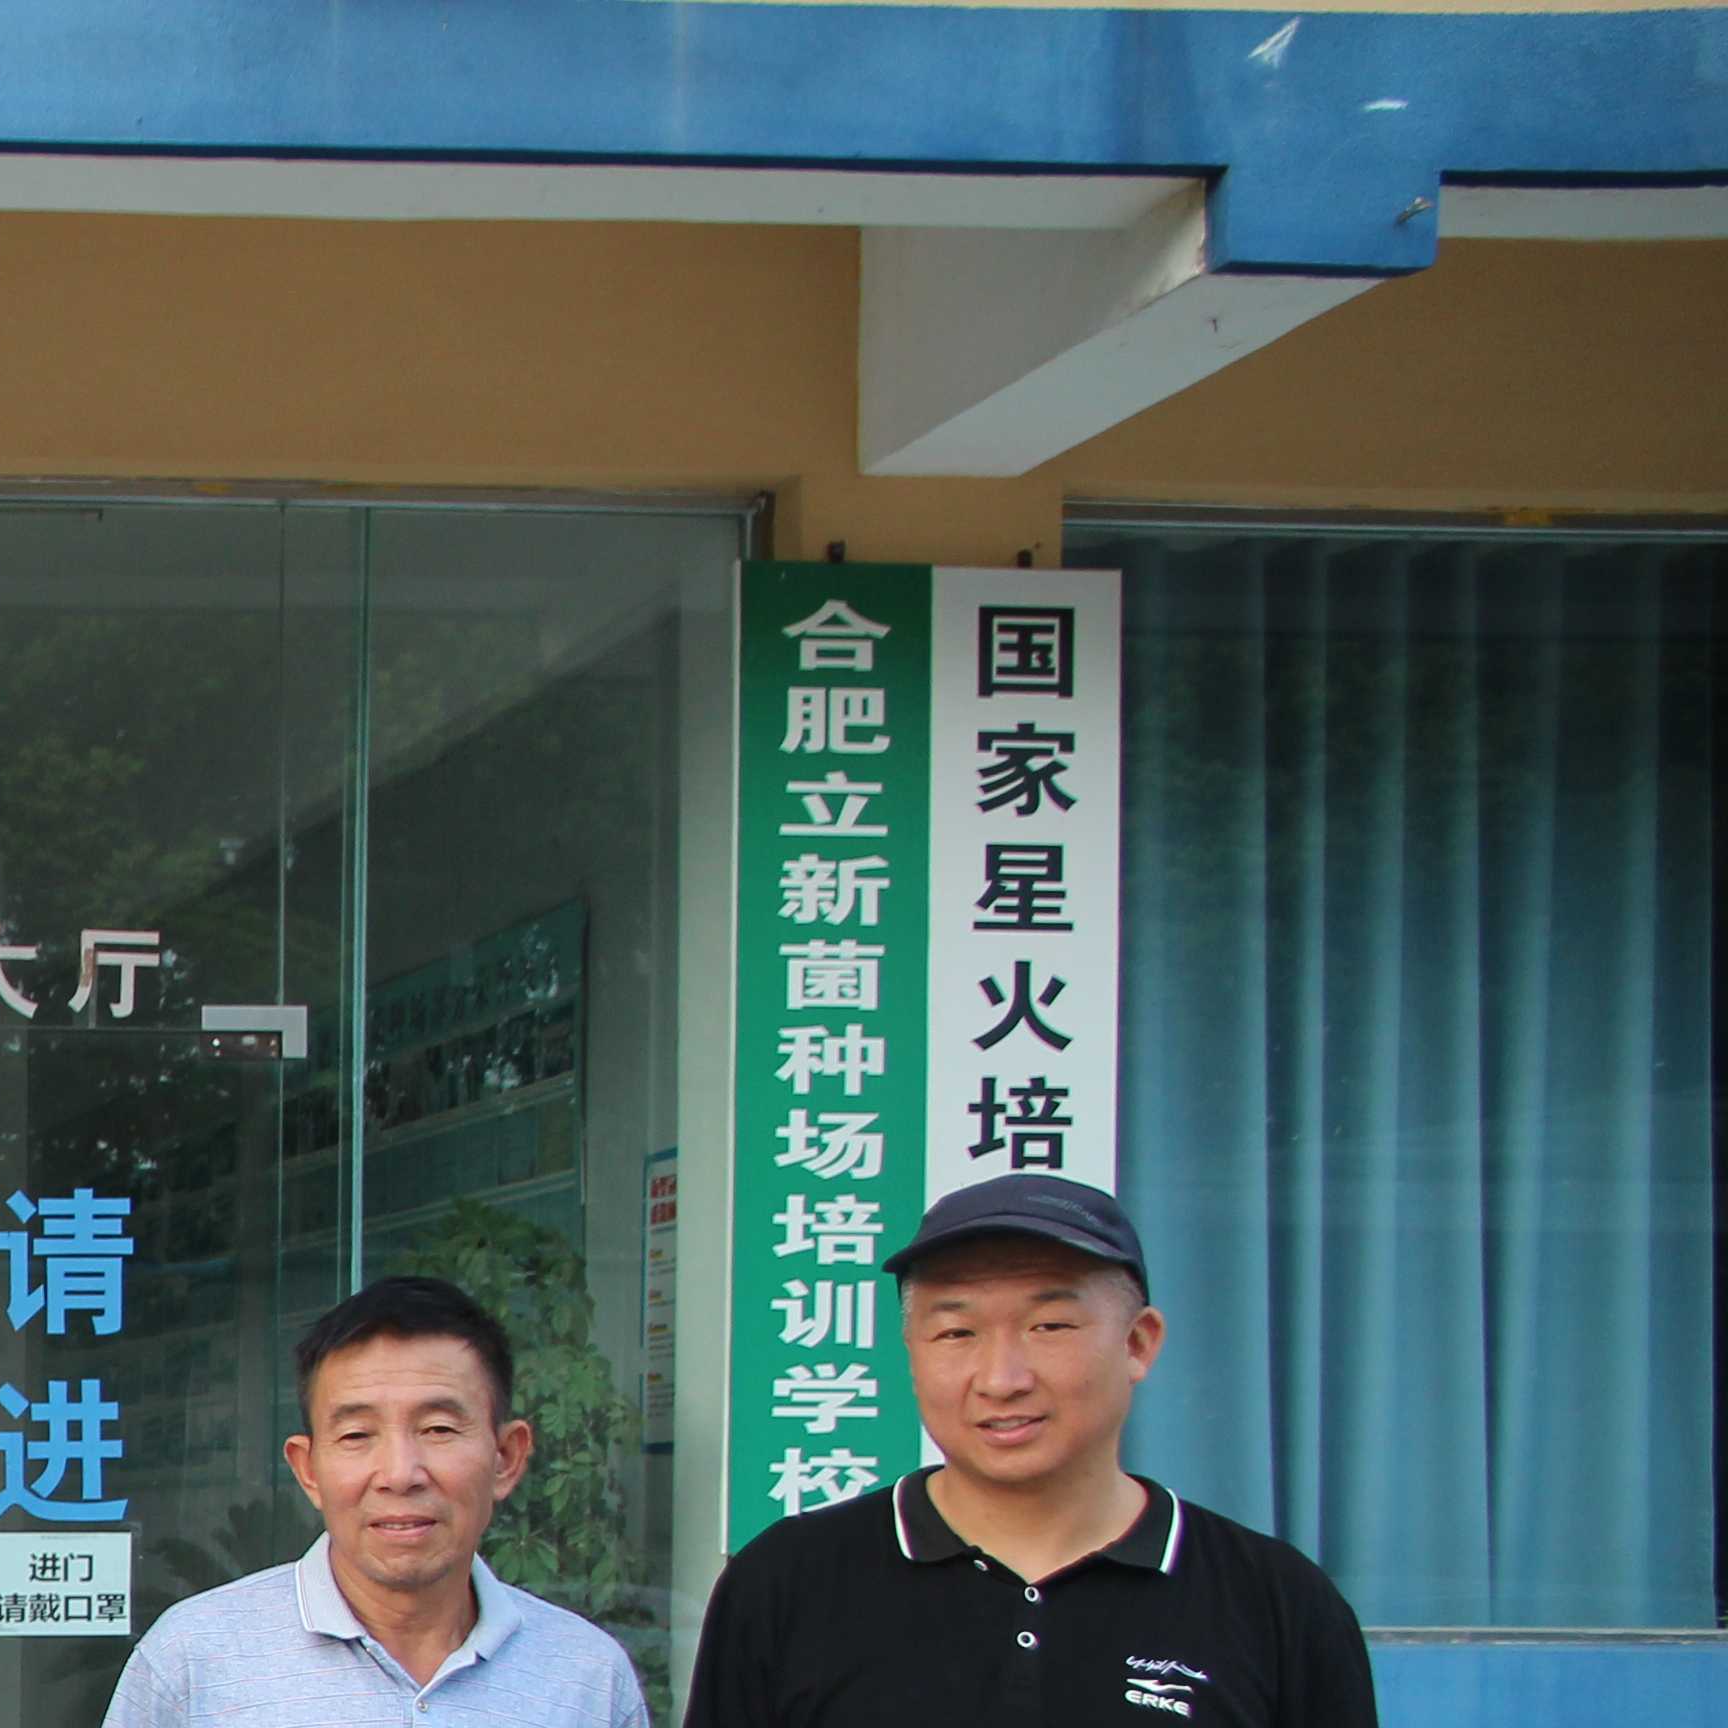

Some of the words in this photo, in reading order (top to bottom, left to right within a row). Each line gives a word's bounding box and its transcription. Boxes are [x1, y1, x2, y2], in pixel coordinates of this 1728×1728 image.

[967, 606, 1076, 1169] 国家星火培
[768, 601, 890, 1515] 合肥立新菌种场培训学校
[29, 1553, 94, 1582] 进门
[1124, 1689, 1191, 1718] ERKE
